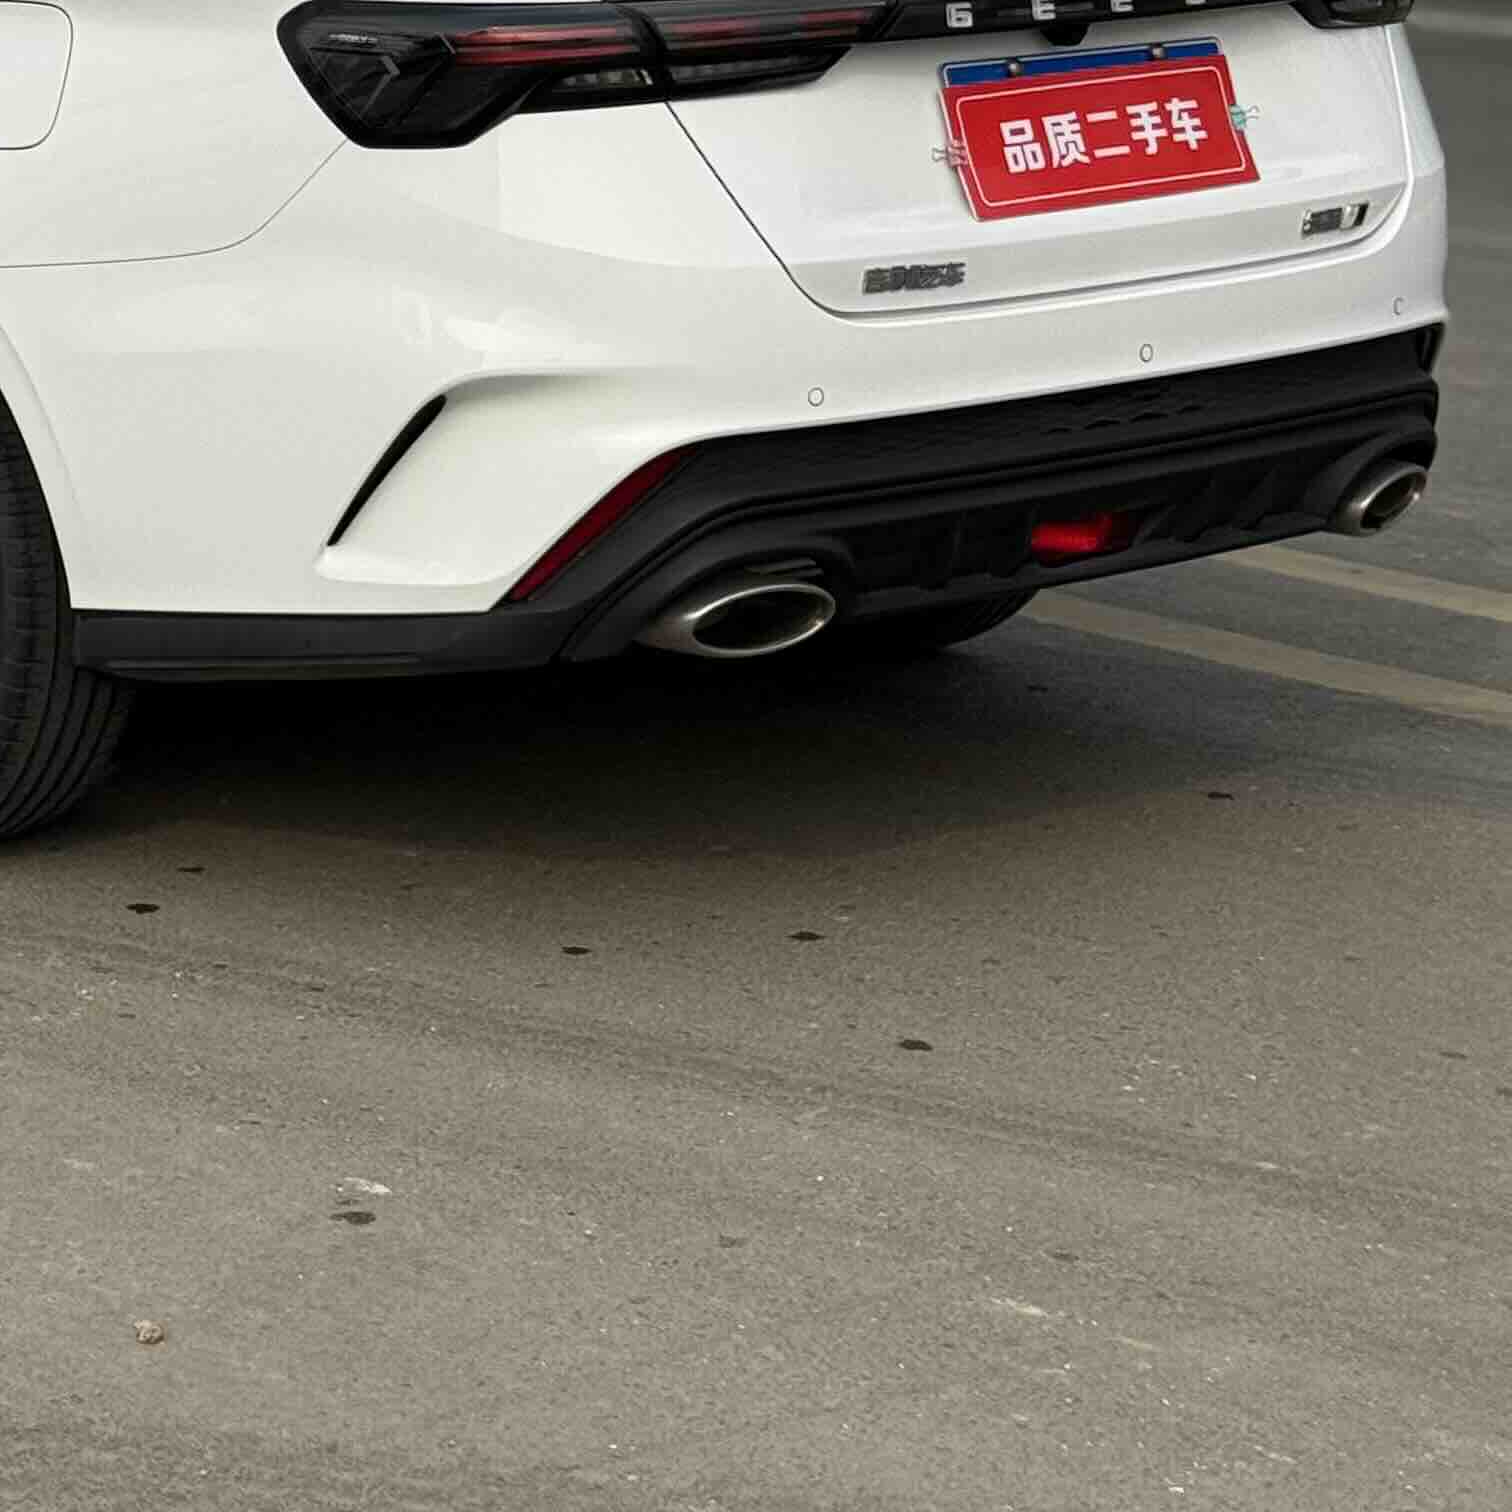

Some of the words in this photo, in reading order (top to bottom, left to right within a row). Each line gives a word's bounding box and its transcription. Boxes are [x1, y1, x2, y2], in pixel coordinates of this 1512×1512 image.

[999, 97, 1209, 174] 品质二手车
